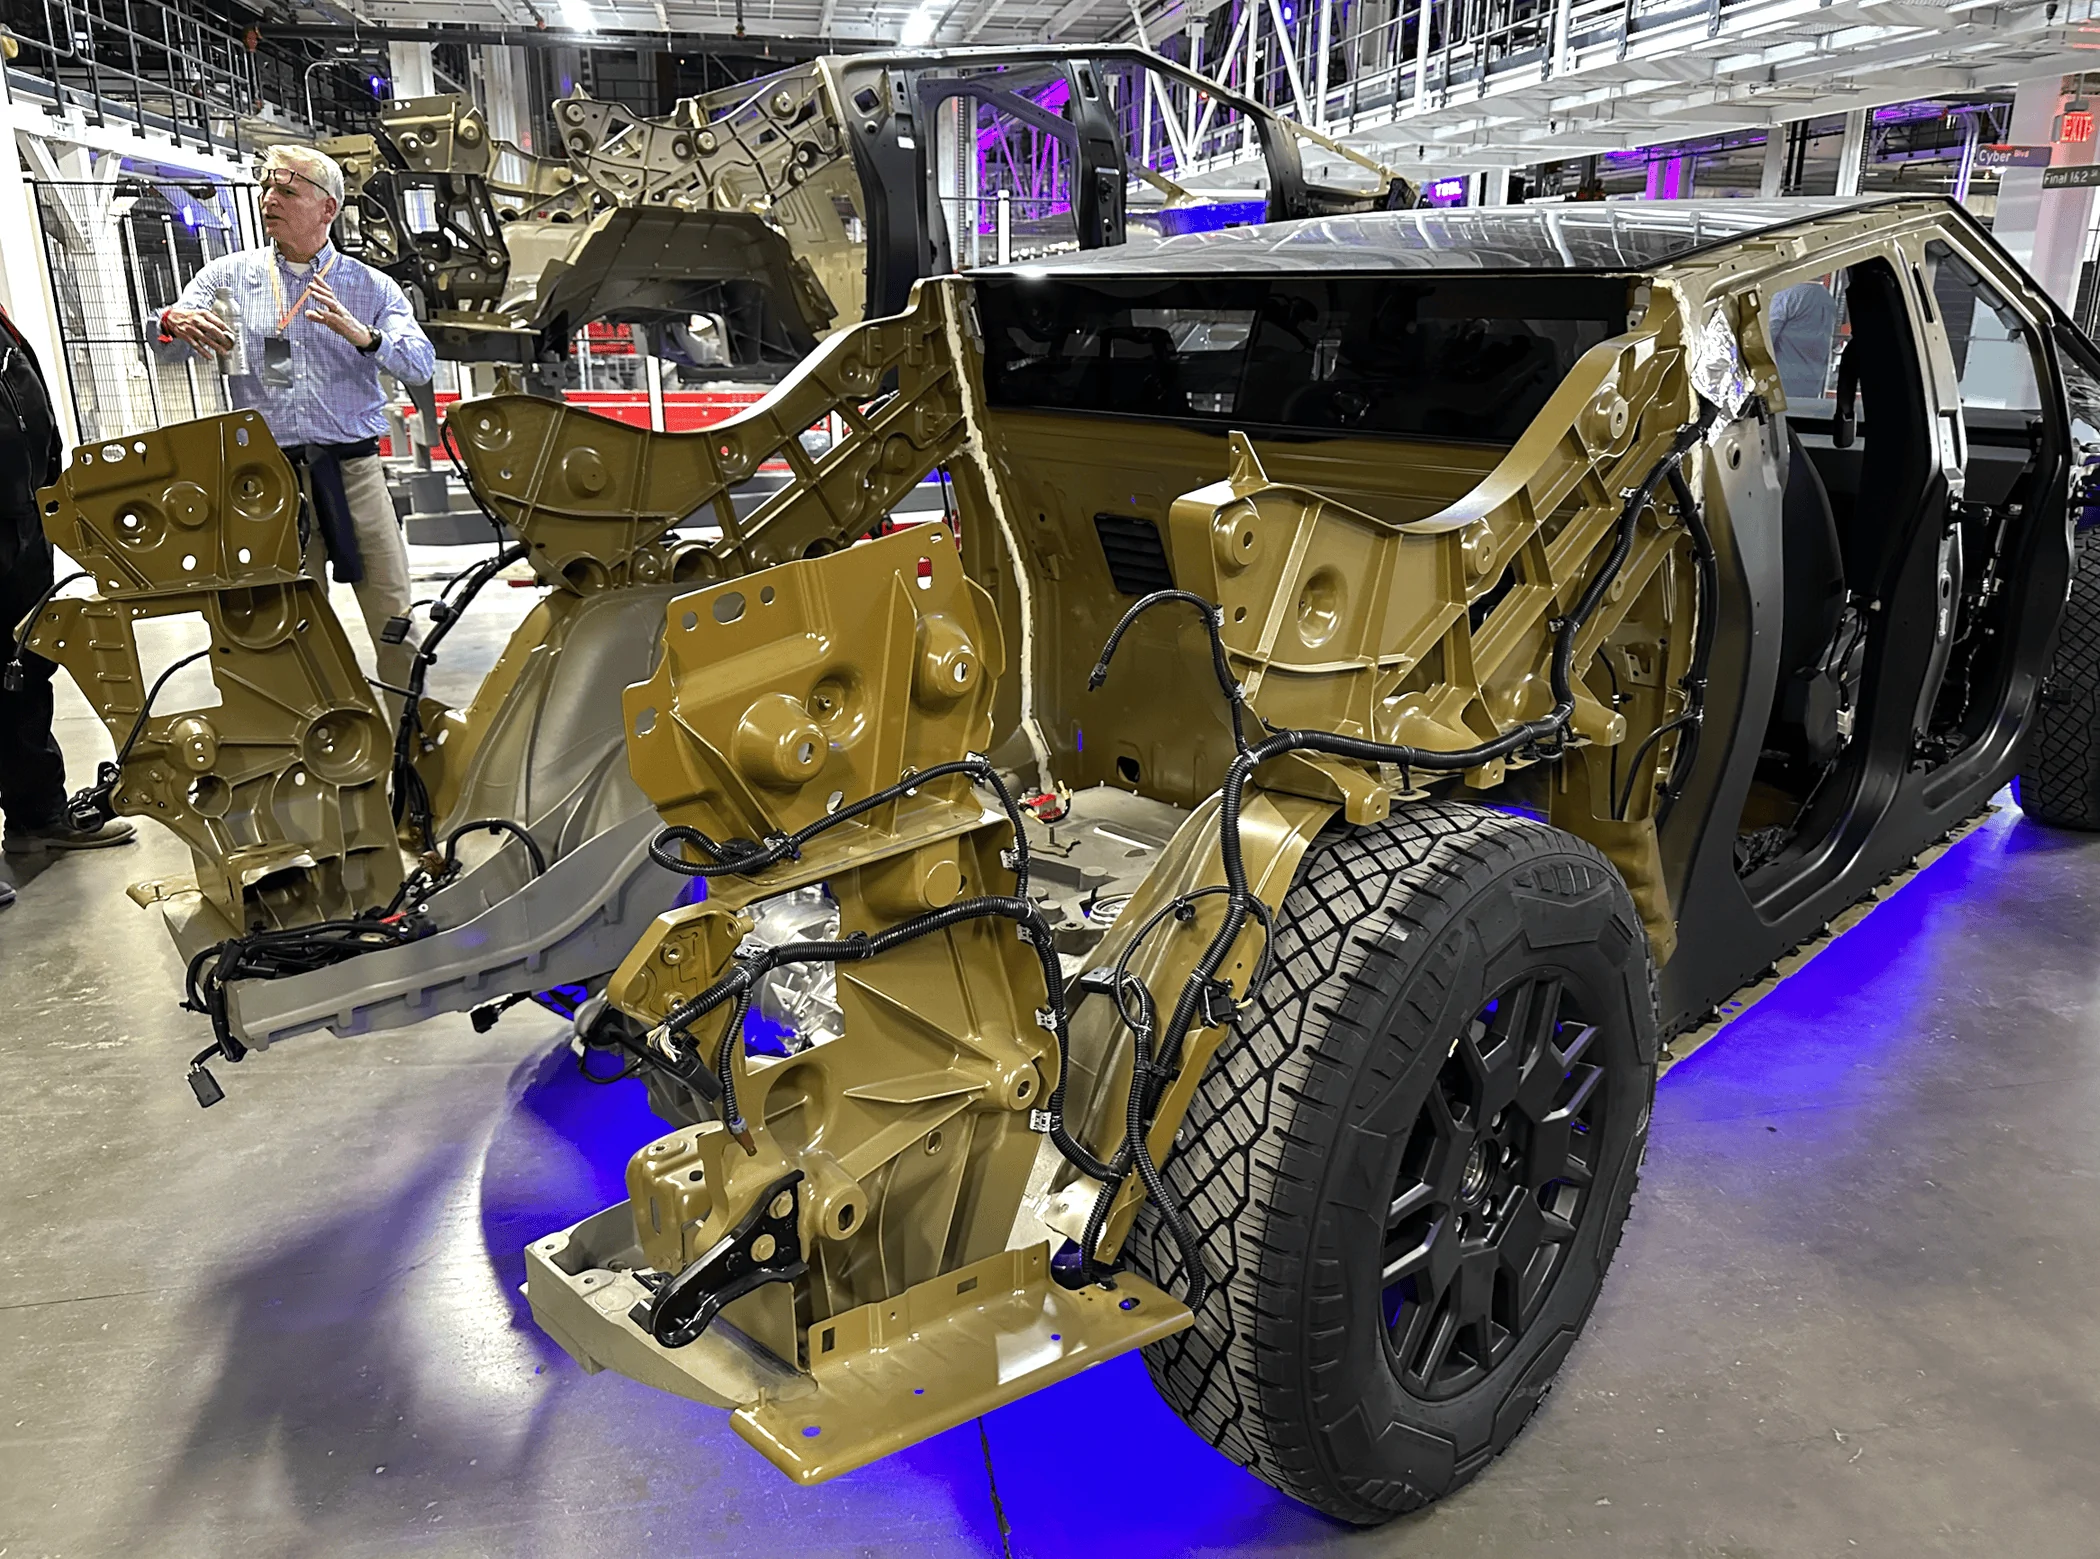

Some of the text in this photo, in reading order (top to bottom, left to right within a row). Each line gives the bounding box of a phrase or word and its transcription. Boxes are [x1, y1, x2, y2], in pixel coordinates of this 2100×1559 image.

[2061, 114, 2092, 142] EXIT
[1979, 149, 2012, 165] Cyber
[2043, 172, 2068, 185] Final
